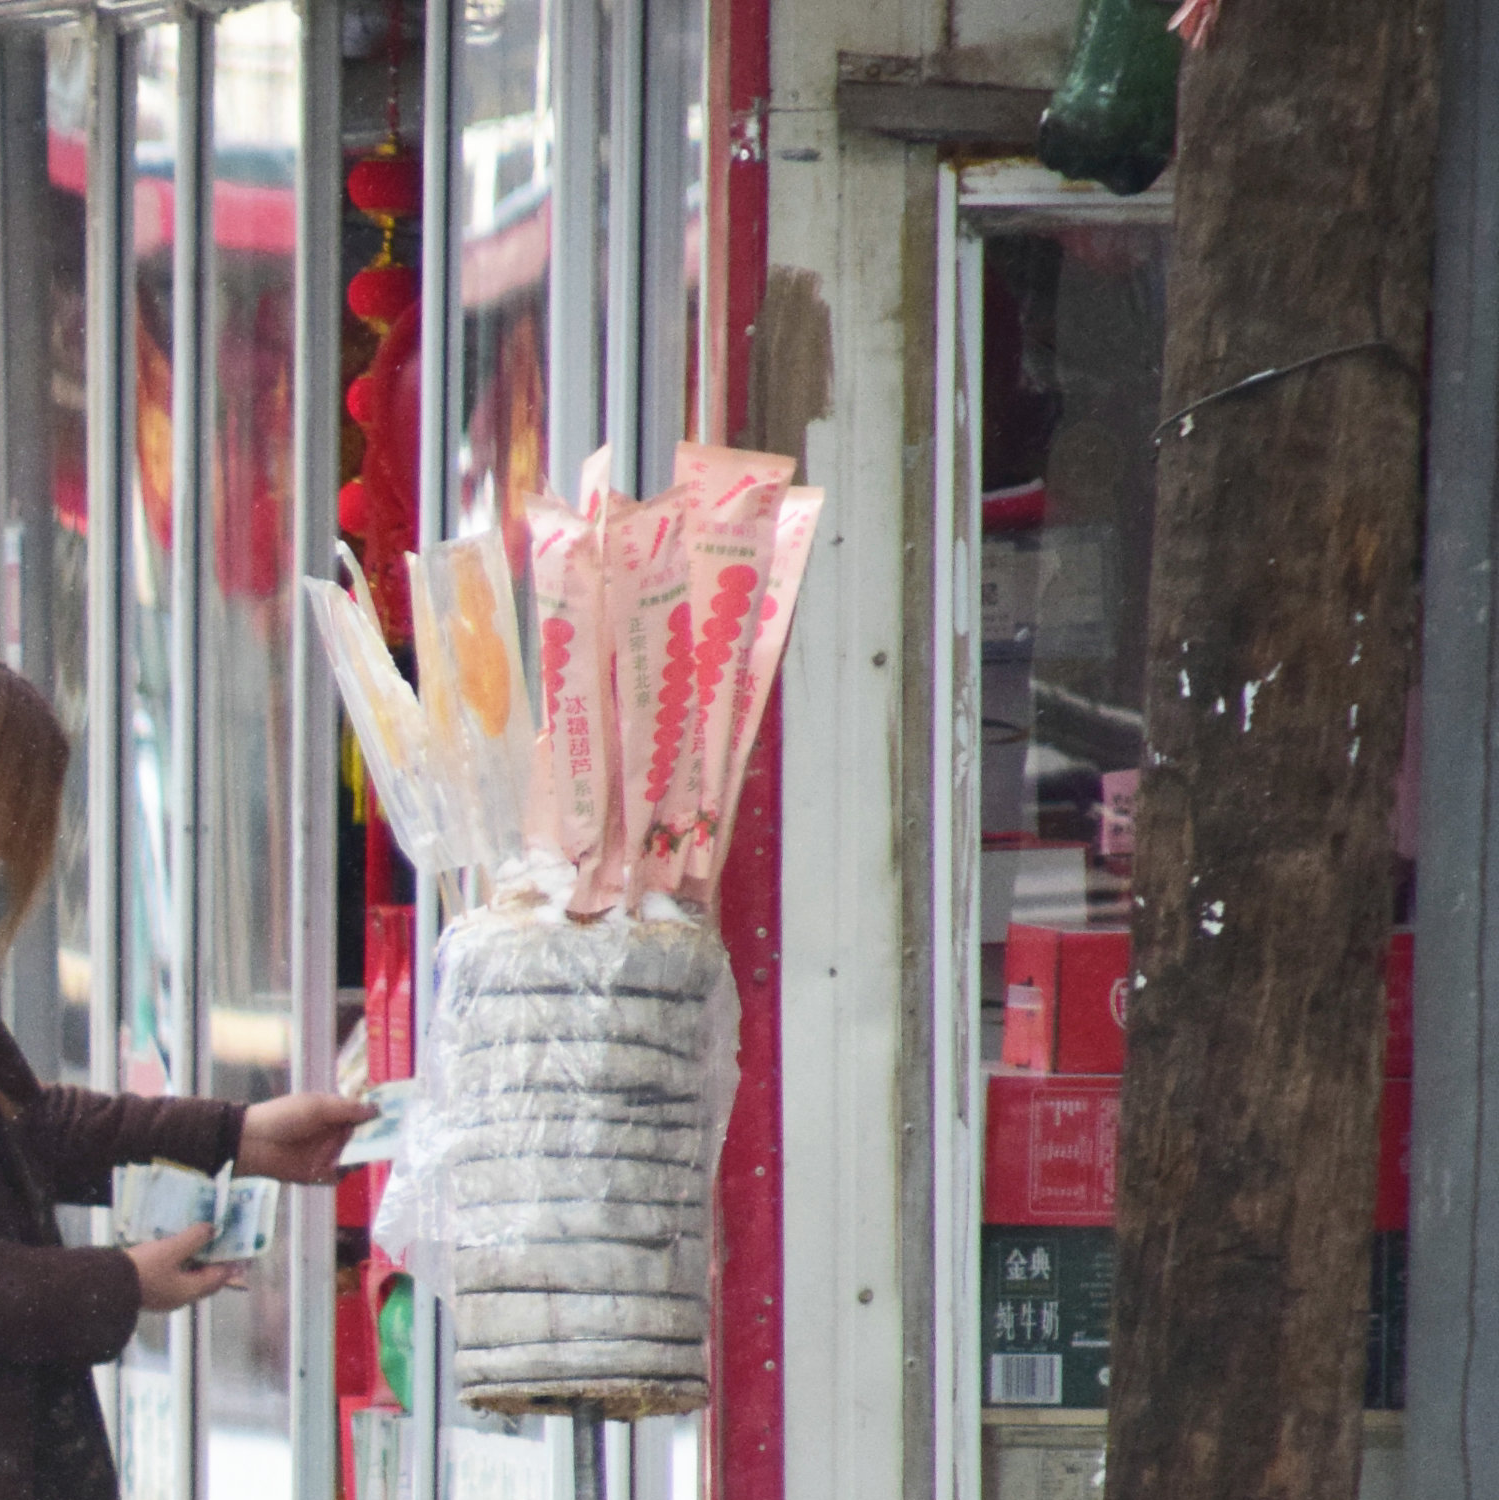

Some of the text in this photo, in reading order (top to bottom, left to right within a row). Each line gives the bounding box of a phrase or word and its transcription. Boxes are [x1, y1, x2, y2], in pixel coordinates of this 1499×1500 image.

[628, 617, 651, 708] 正宗老北京
[1005, 1246, 1051, 1282] 金典
[995, 1299, 1060, 1343] 纯牛奶
